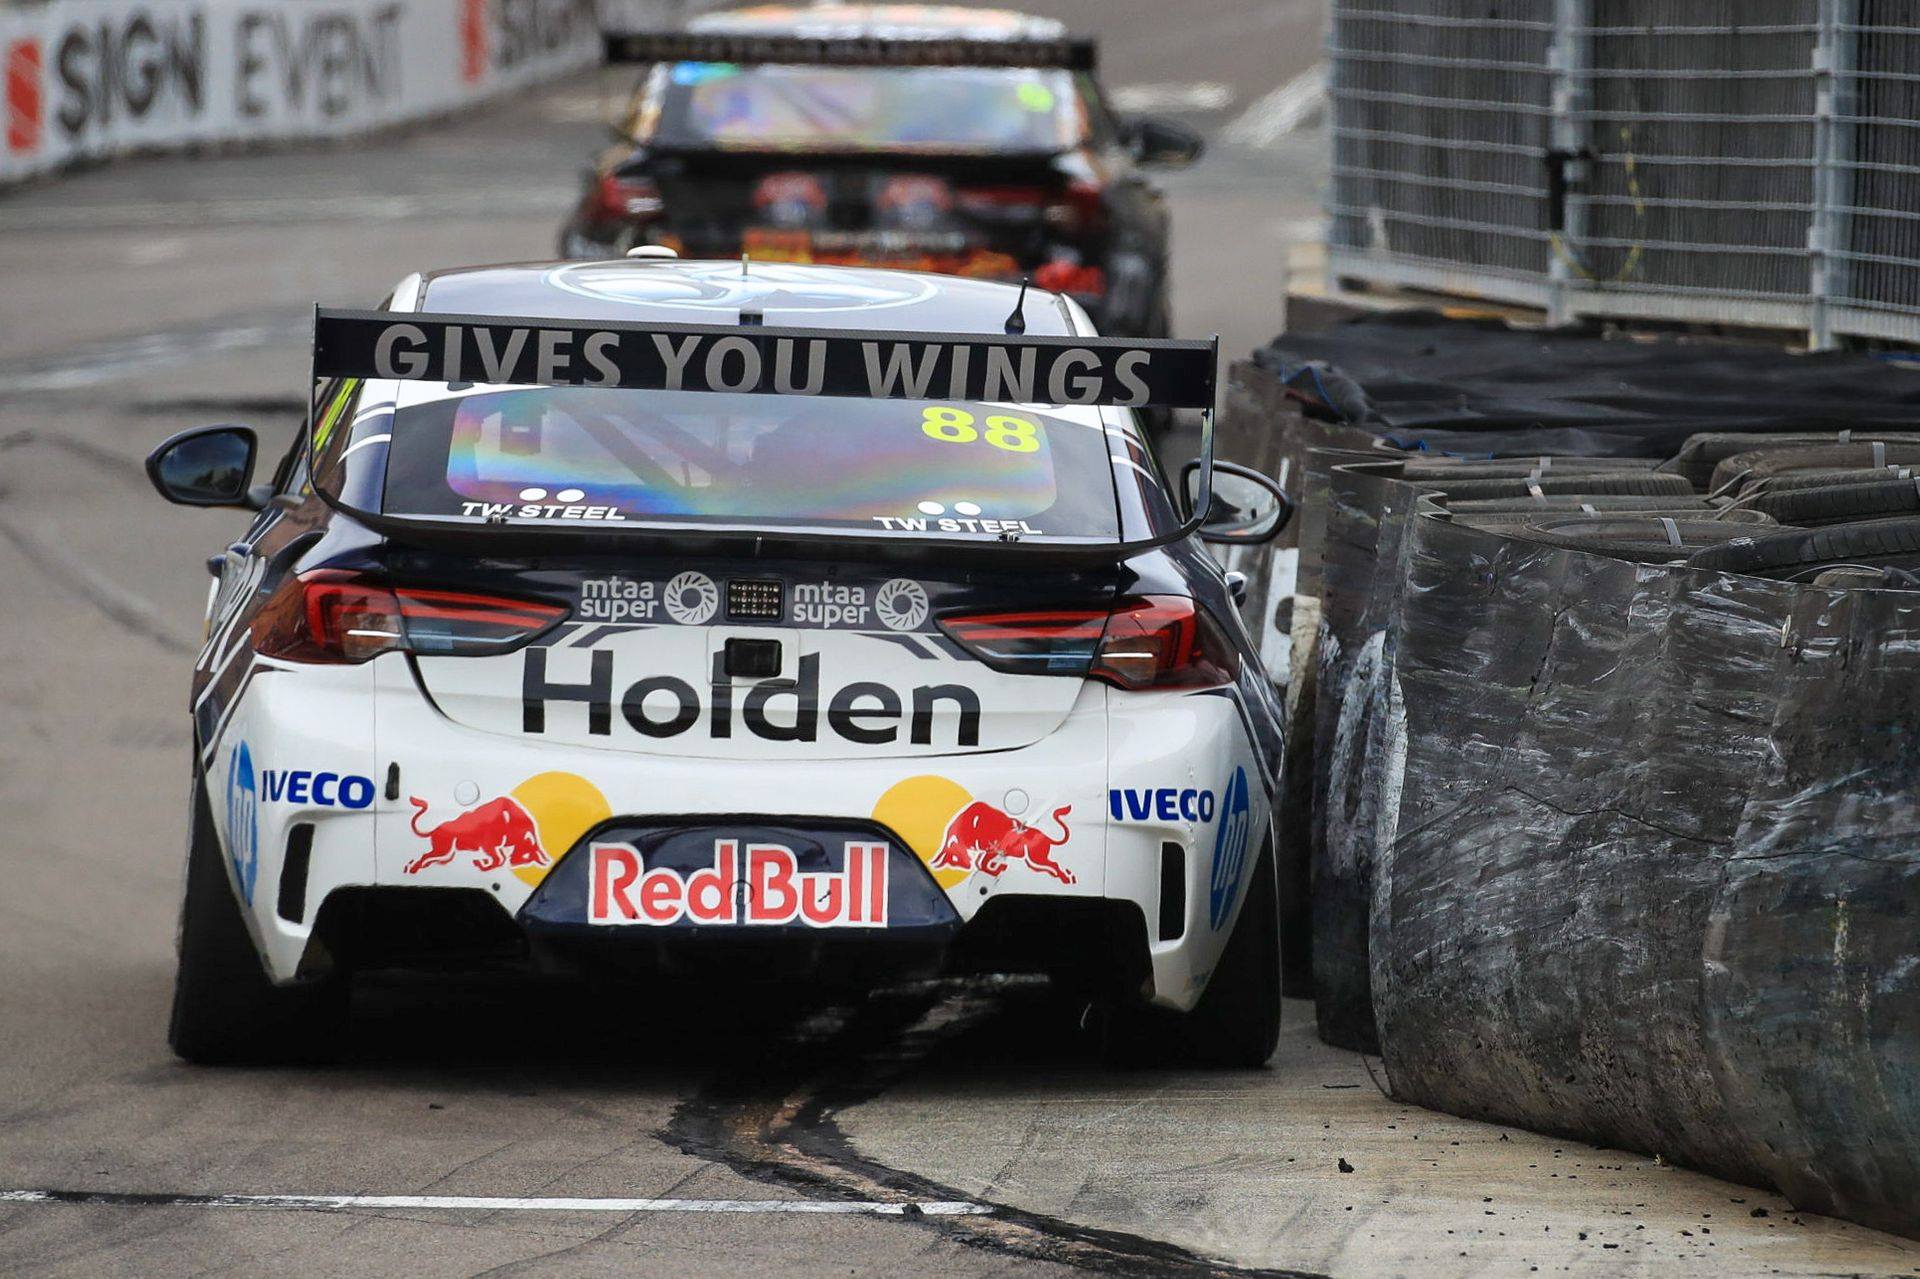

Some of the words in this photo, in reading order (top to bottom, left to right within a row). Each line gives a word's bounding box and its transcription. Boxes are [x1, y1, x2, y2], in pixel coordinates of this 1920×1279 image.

[57, 7, 205, 136] SIGN
[235, 5, 402, 118] EVENT
[374, 323, 621, 386] GIVES
[652, 333, 828, 395] YOU
[862, 342, 1151, 406] WINGS
[921, 406, 1040, 453] 88
[462, 502, 513, 519] TW
[518, 504, 626, 520] STEEL
[873, 517, 927, 531] TW
[938, 518, 1043, 535] STEEL
[582, 576, 653, 599] mtaa
[793, 581, 865, 606] mtaa
[580, 598, 659, 621] super
[793, 601, 870, 628] super
[523, 646, 981, 746] Holden
[261, 770, 376, 809] IVECO
[1109, 788, 1215, 823] IVECO
